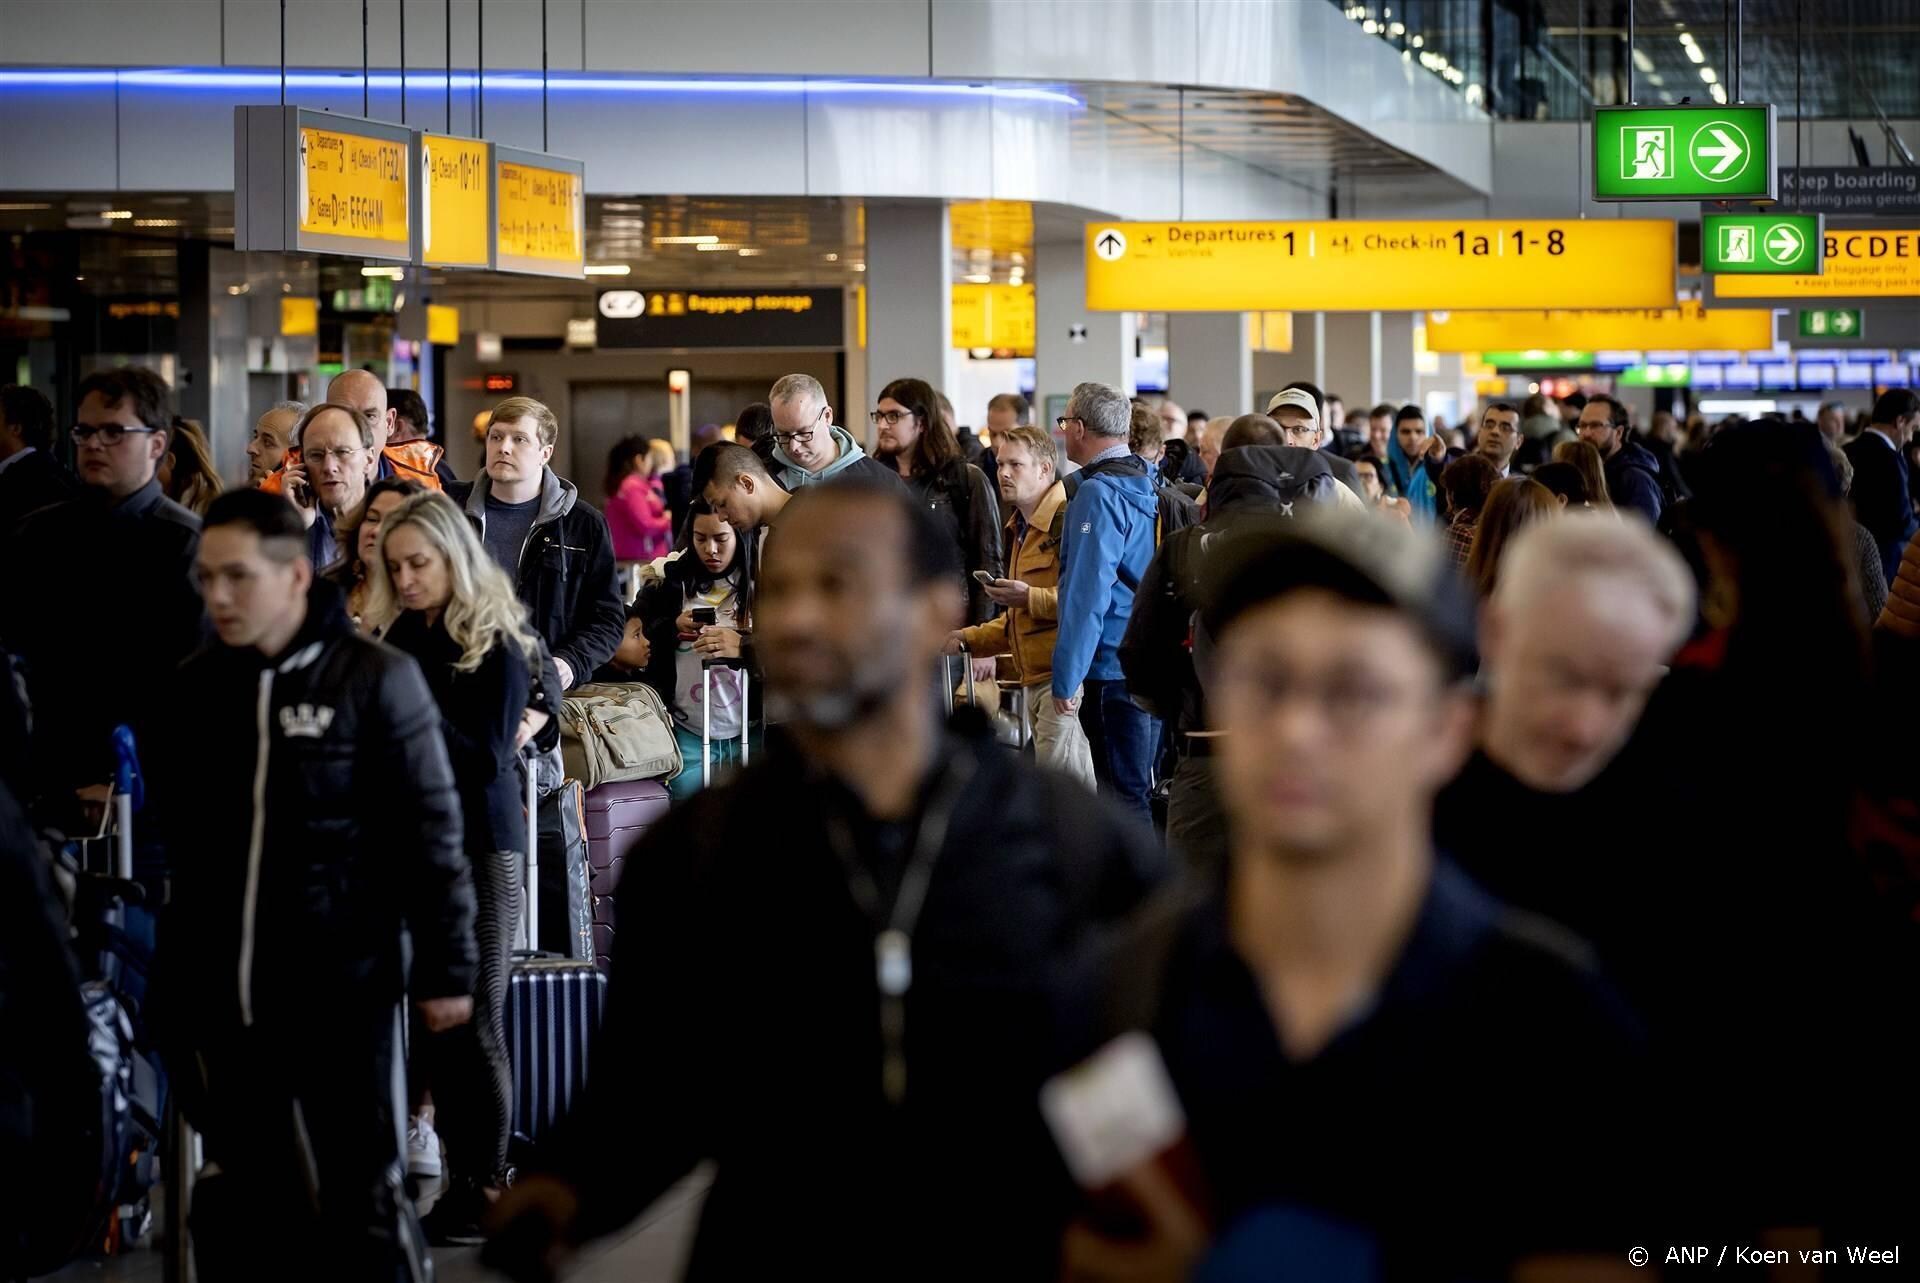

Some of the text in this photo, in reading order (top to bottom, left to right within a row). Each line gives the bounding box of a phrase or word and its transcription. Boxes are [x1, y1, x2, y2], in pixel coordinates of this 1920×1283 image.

[338, 138, 345, 174] 3
[378, 146, 399, 181] 17-32
[459, 152, 480, 190] 10-11
[1782, 172, 1917, 191] Keep boarding
[317, 198, 332, 218] Gates
[1168, 226, 1566, 256] Departures 1 Check-in 1a 1-8
[687, 294, 813, 314] Baggage storage
